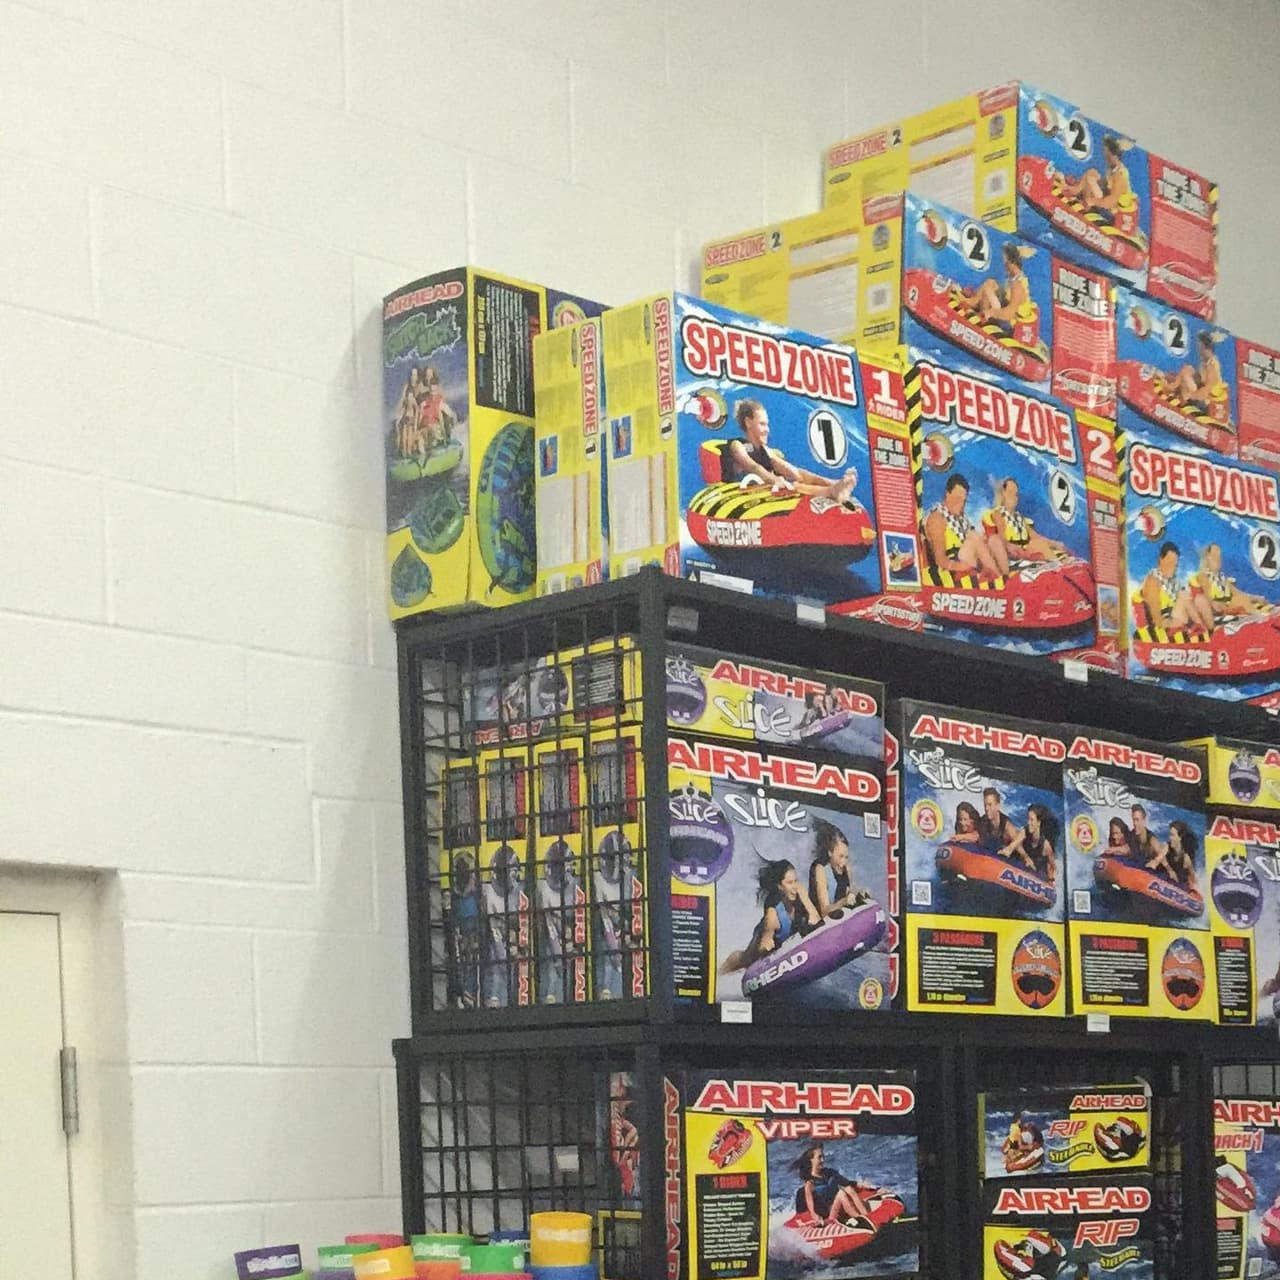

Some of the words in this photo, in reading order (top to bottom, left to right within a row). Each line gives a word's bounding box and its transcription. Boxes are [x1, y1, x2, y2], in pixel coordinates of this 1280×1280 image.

[1069, 121, 1086, 152] 2
[968, 225, 986, 262] 2
[1169, 319, 1185, 350] 2
[872, 371, 901, 403] 1
[817, 418, 838, 461] 1
[1087, 430, 1113, 467] 2
[1057, 477, 1071, 514] 2
[1258, 534, 1276, 572] 2
[712, 659, 878, 718] AIRHEAD
[910, 713, 1067, 762] AIRHEAD
[668, 739, 881, 802] AIRHEAD
[1068, 736, 1201, 784] AIRHEAD
[694, 1079, 915, 1115] AIRHEAD
[1070, 1094, 1147, 1111] AIRHEAD
[754, 1118, 858, 1141] VIPER
[1049, 1119, 1088, 1139] RIP
[992, 1187, 1152, 1216] AIRHEAD
[1072, 1219, 1139, 1250] RIP
